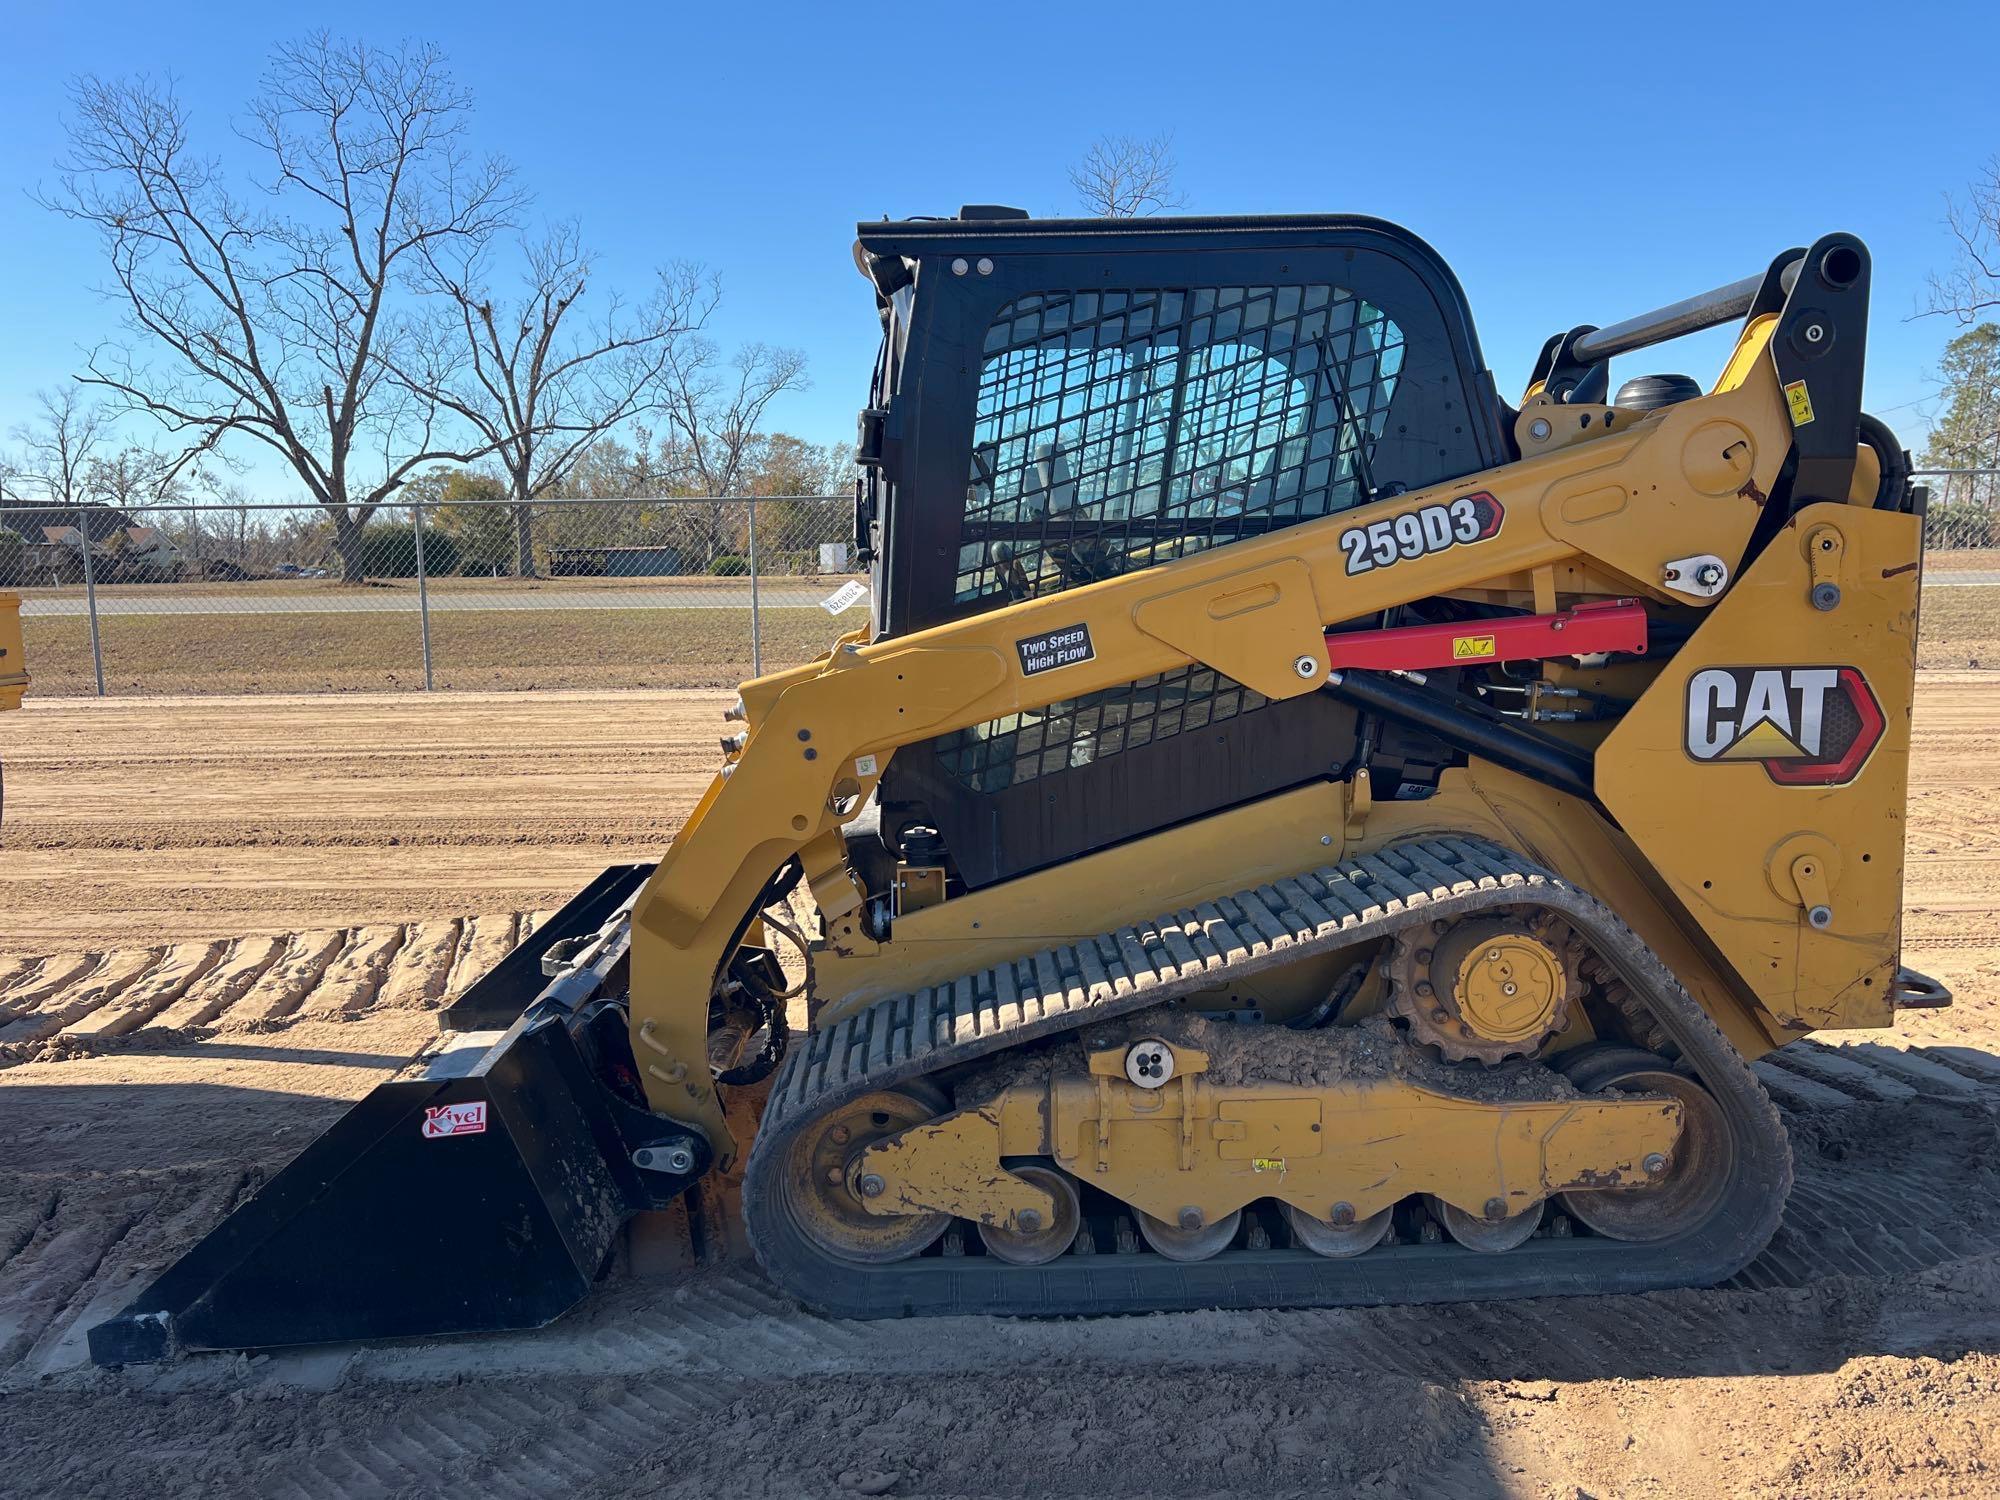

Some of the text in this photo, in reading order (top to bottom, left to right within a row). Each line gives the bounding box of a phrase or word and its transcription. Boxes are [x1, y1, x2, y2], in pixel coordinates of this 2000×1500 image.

[1341, 499, 1480, 574] 259D3
[1688, 669, 1838, 759] CAT
[428, 1106, 482, 1134] Kivel
